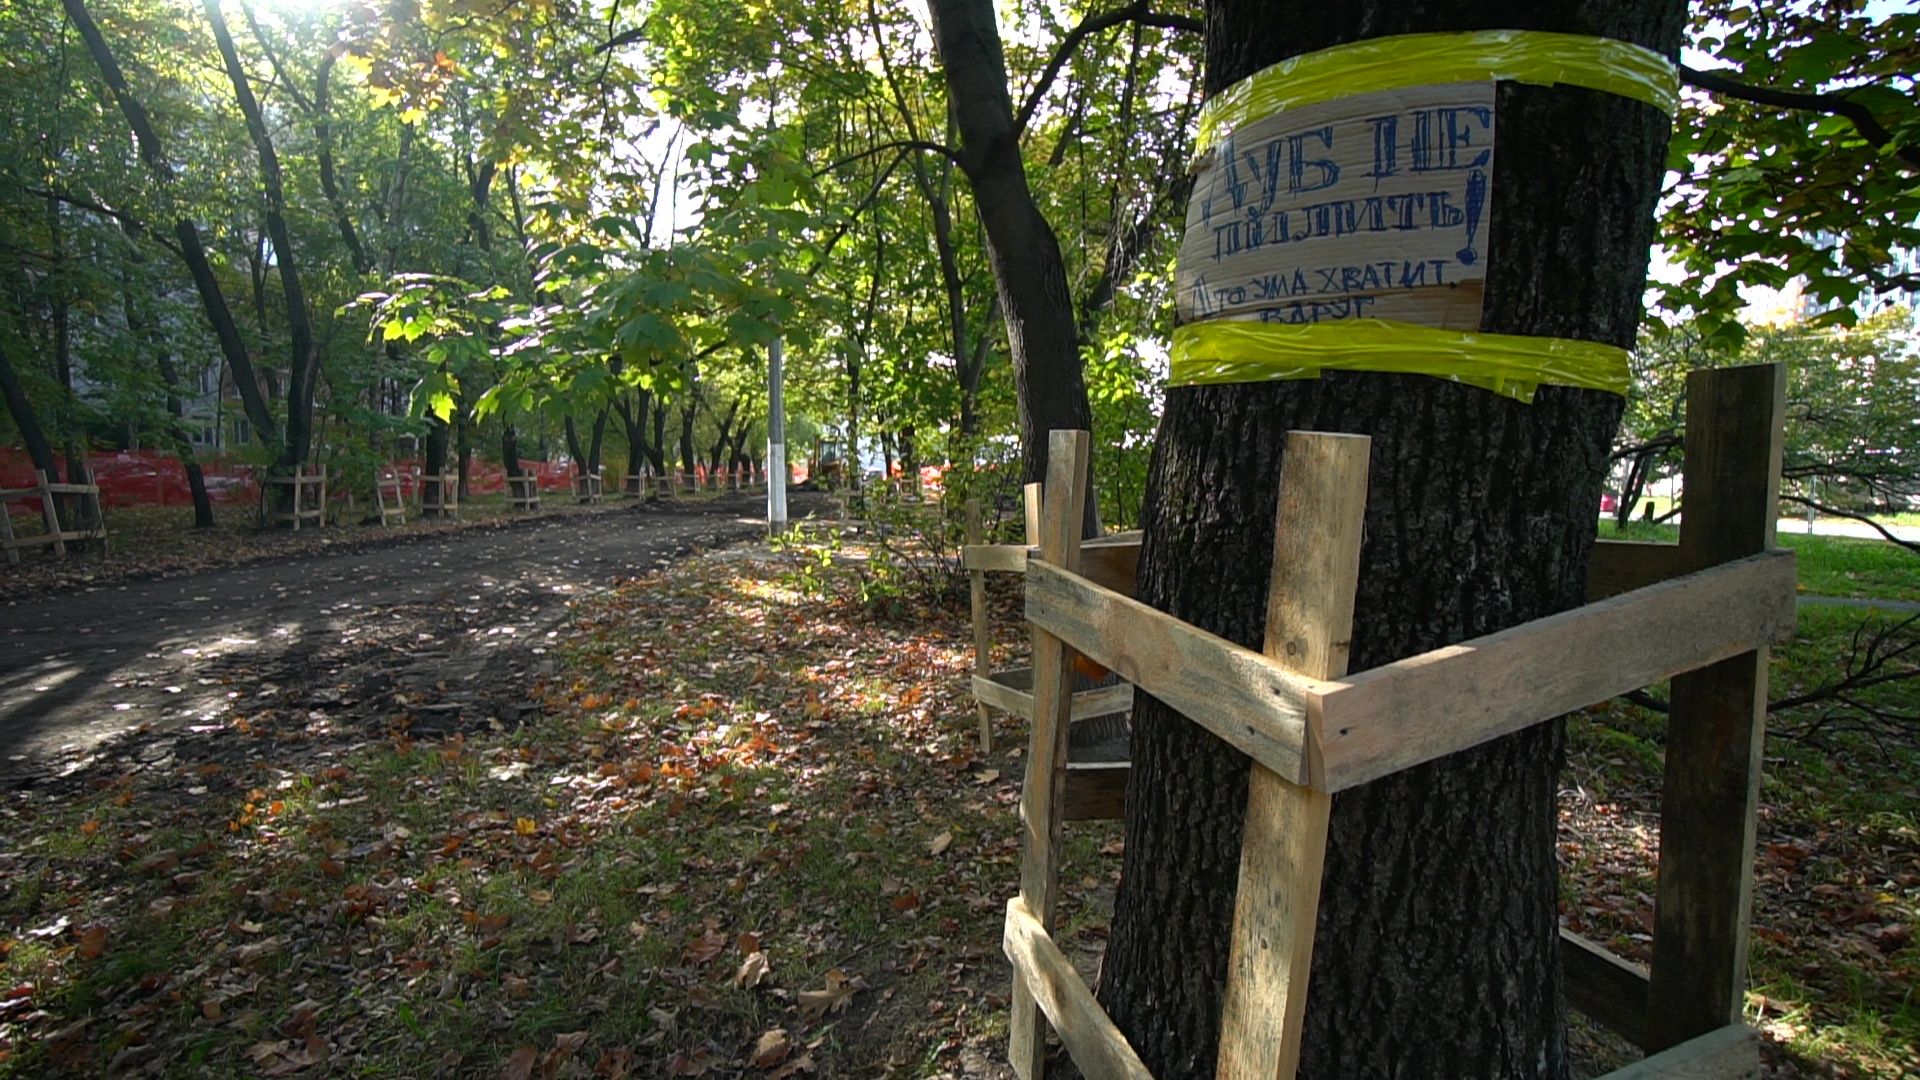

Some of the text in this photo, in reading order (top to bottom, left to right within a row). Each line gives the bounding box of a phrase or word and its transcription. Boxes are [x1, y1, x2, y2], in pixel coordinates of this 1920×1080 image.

[1202, 106, 1492, 231] ДУБ НЕ
[1209, 168, 1487, 265] ПИЛИТЬ!
[1213, 286, 1246, 311] ТО
[1251, 266, 1309, 301] УМА
